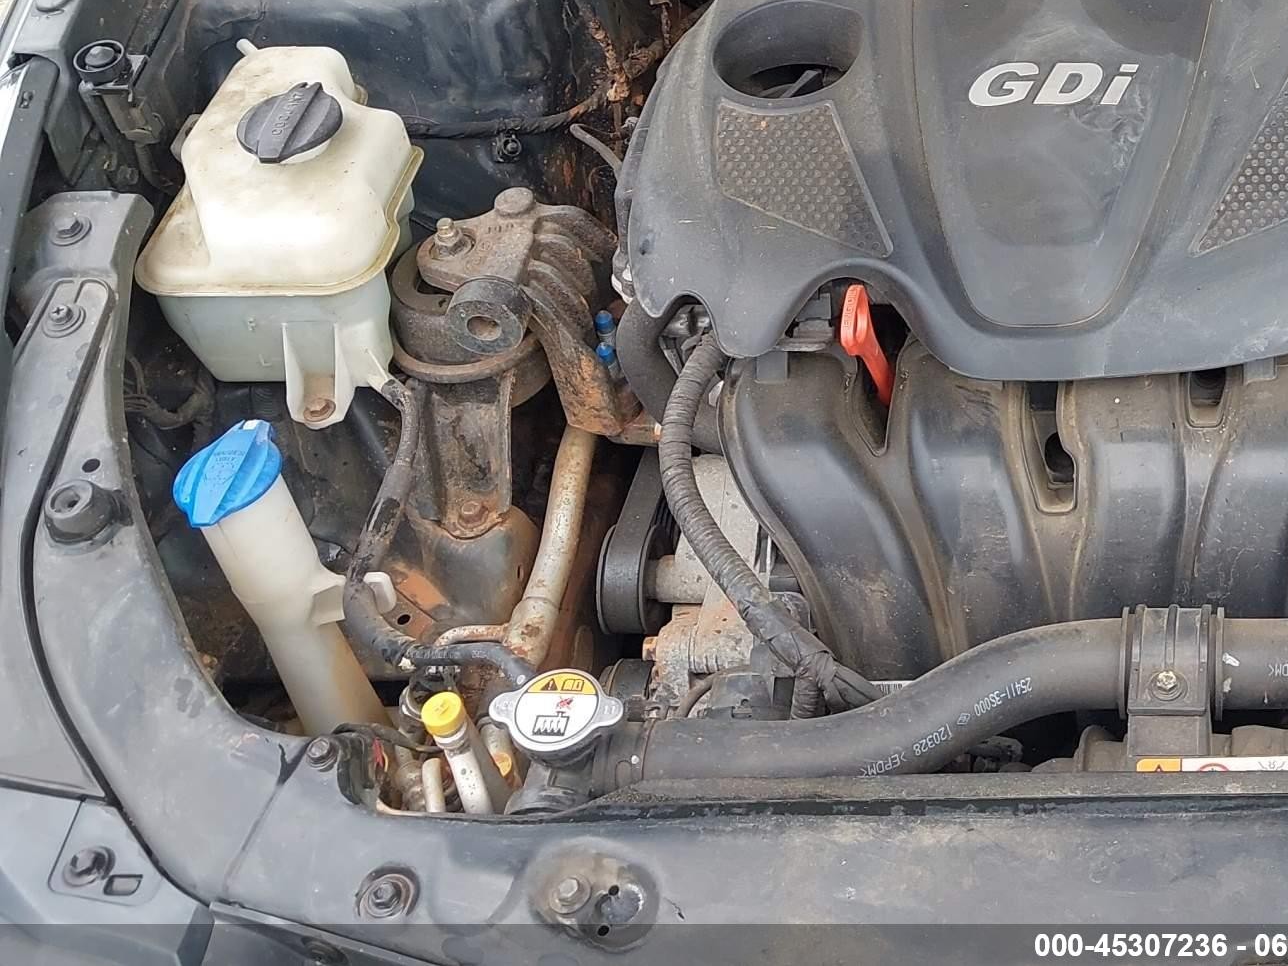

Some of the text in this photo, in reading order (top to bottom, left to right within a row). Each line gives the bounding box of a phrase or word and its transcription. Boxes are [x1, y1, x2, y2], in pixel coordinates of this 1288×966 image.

[968, 61, 1140, 107] GDi
[974, 677, 1033, 717] 25411-3S000
[913, 723, 953, 756] 120328
